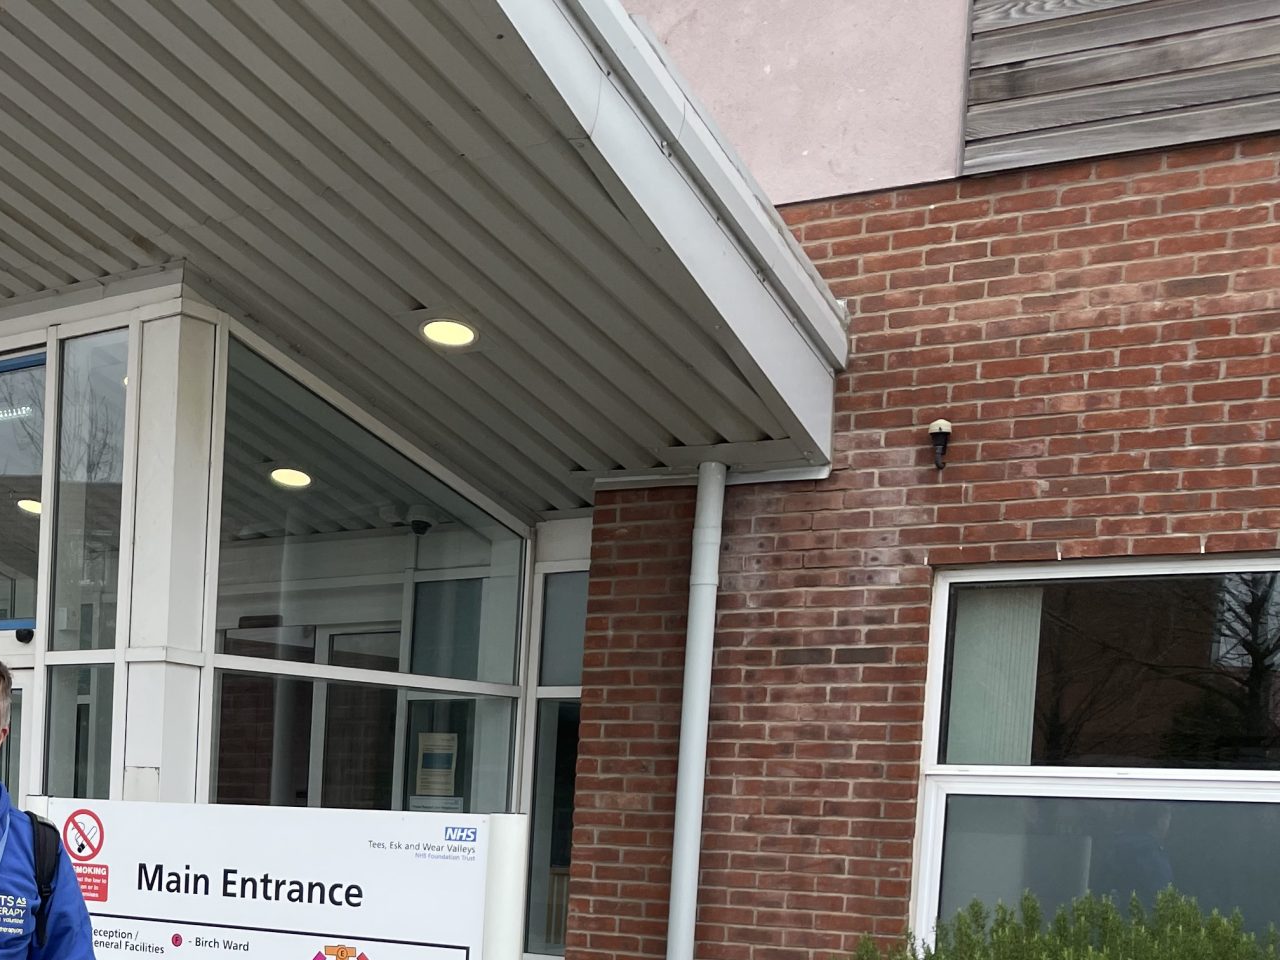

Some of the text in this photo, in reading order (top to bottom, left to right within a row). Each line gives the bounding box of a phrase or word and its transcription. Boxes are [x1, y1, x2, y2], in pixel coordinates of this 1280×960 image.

[445, 827, 476, 841] NHS
[368, 840, 476, 855] Tees, Esk and Wear Valleys
[428, 853, 460, 861] Foundation
[461, 854, 476, 862] Trust
[137, 862, 364, 908] Main Entrance
[16, 896, 27, 905] AS
[93, 928, 133, 940] eception
[93, 939, 165, 954] eneral Facilities
[195, 937, 220, 949] Birch
[223, 939, 249, 951] Ward
